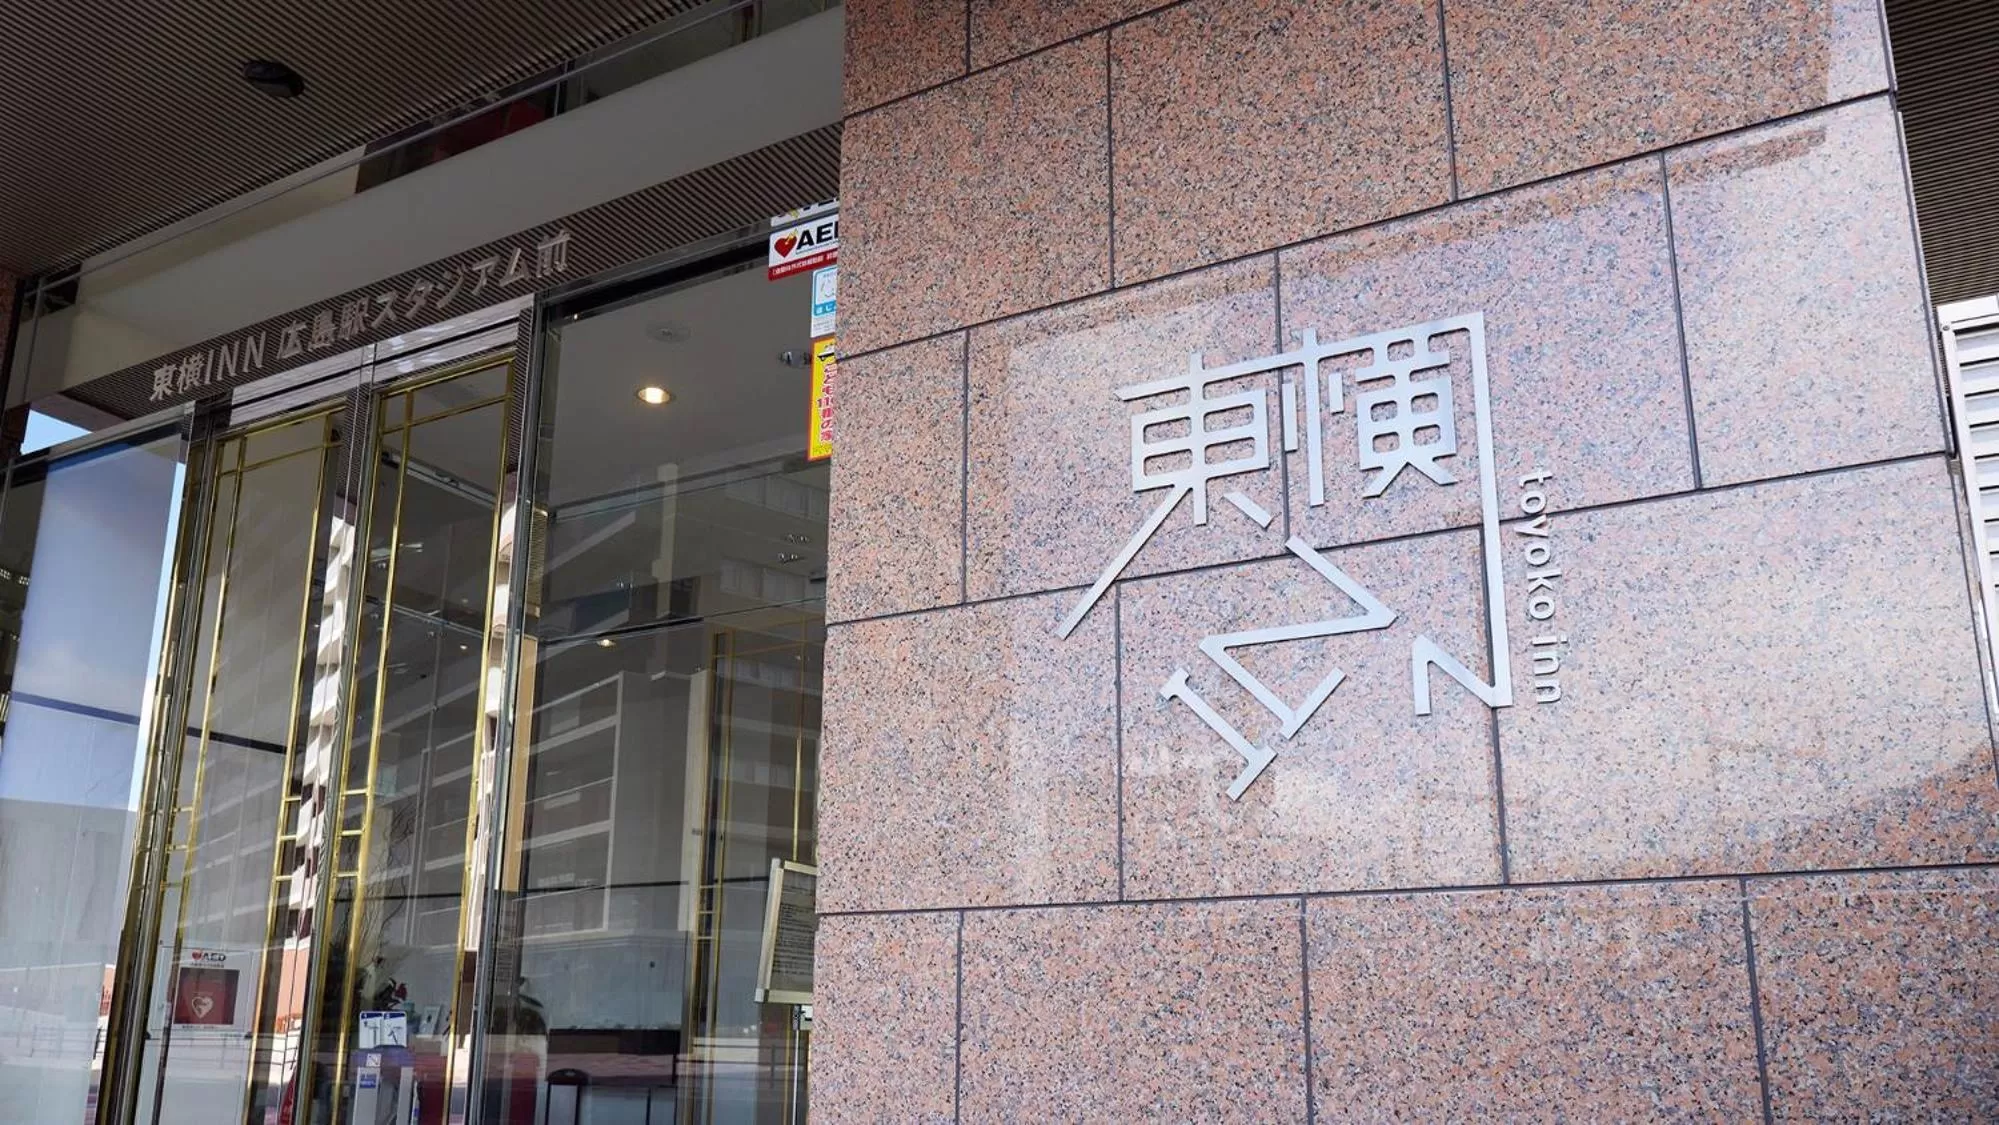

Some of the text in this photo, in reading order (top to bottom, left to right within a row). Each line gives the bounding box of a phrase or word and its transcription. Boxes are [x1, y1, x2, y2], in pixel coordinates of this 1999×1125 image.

[276, 229, 571, 360] 広島駅スタジアム前
[1514, 469, 1568, 704] toyoko inn
